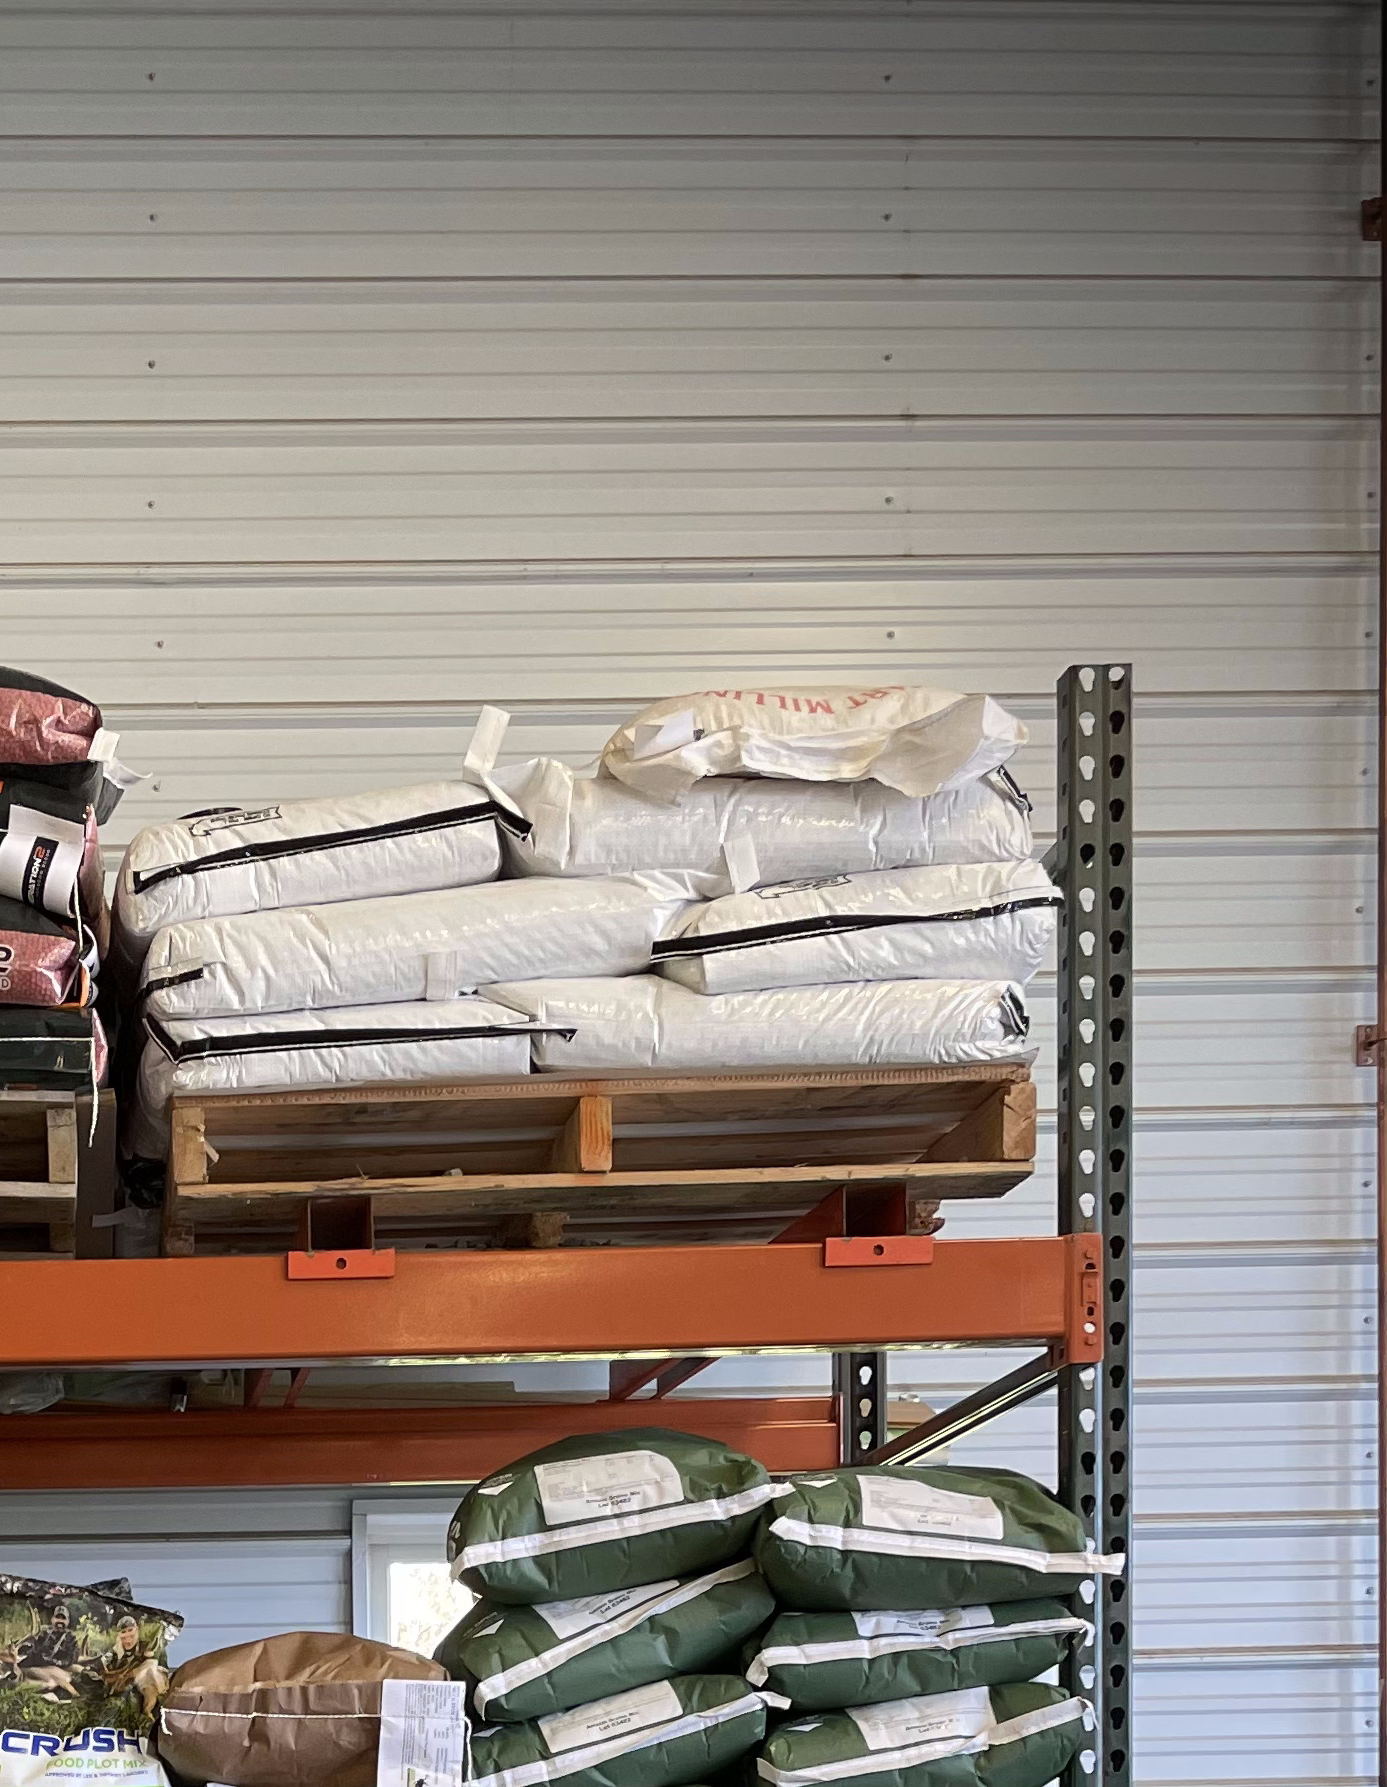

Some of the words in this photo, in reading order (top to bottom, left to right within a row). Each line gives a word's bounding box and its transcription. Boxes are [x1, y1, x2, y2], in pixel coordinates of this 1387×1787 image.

[1, 1728, 141, 1756] CRUSH
[87, 1758, 120, 1770] PLOT
[123, 1758, 146, 1770] MIX
